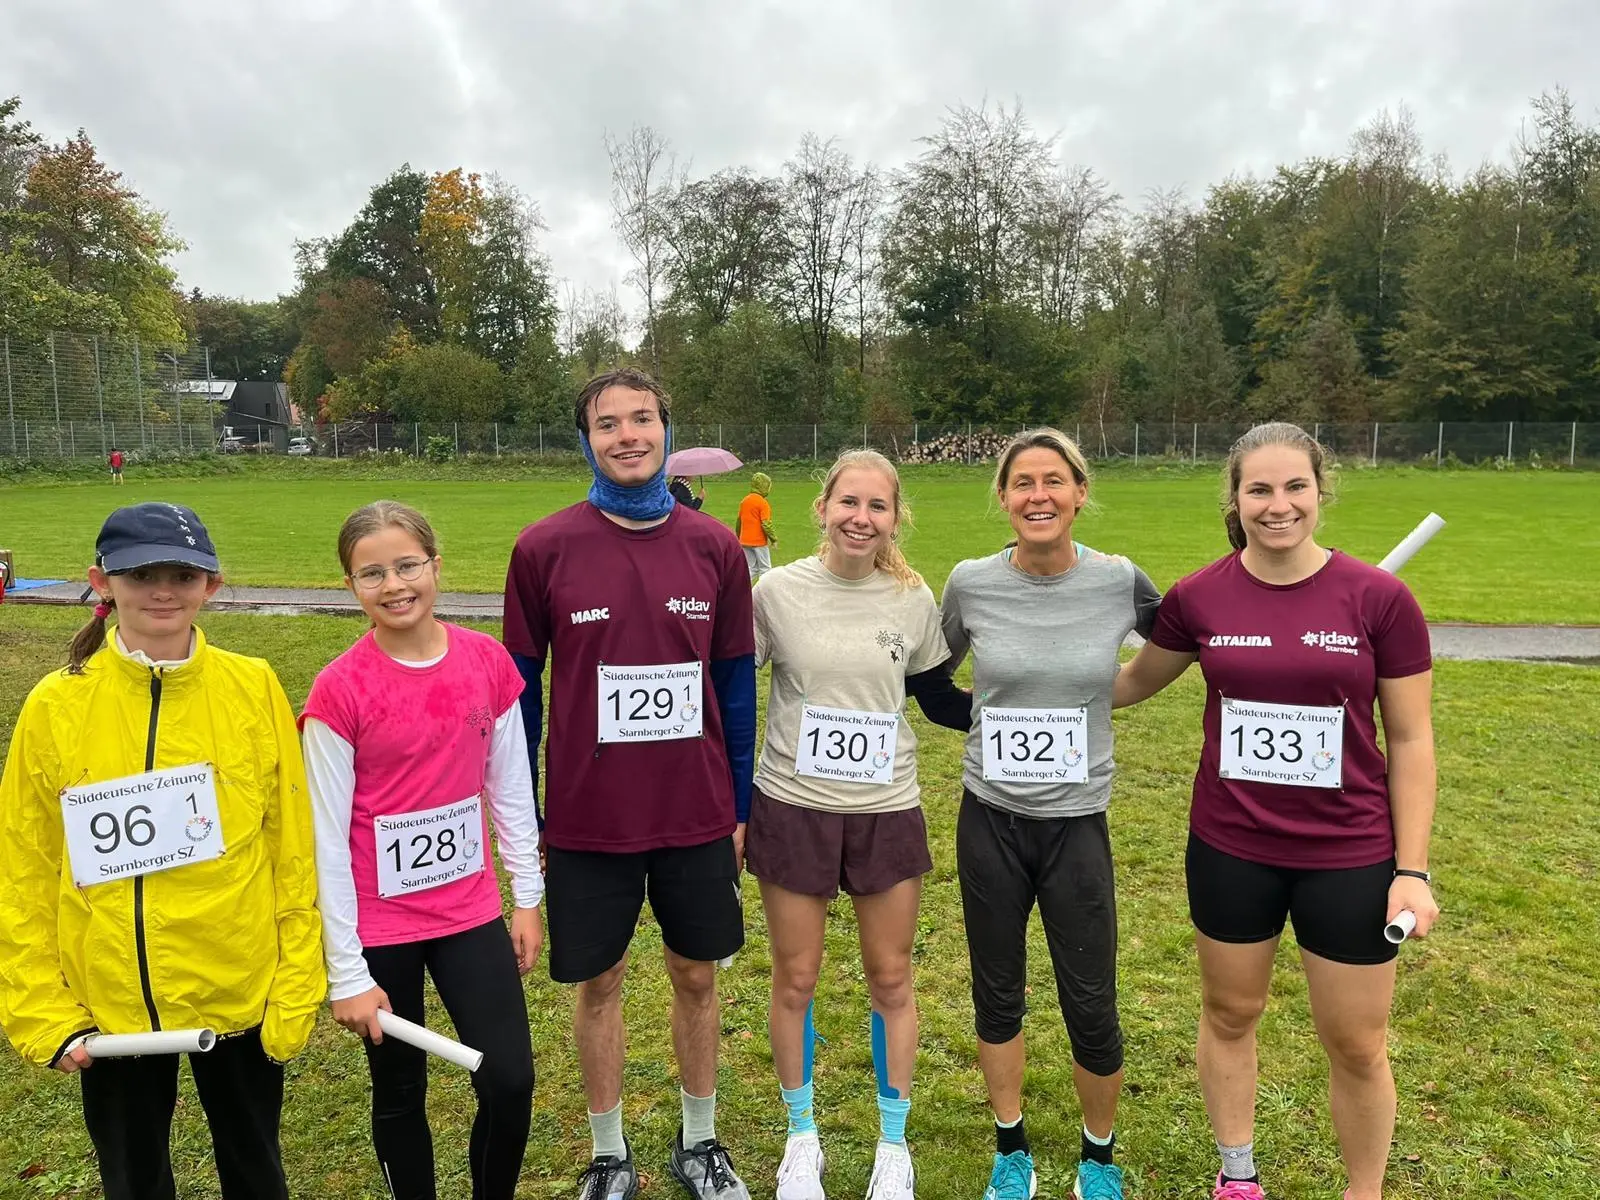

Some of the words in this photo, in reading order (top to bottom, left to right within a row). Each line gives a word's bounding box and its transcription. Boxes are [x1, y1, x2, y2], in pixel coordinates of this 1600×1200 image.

[571, 607, 610, 624] MARC
[681, 597, 710, 614] jdav
[686, 613, 710, 621] Starnberg
[1319, 630, 1358, 647] jdav
[1325, 645, 1358, 656] Starnberg
[603, 671, 666, 681] Süddeutsche
[666, 669, 699, 680] Zeitung
[607, 687, 674, 721] 129
[683, 684, 690, 702] 1
[806, 709, 864, 725] Süddeutsche
[864, 716, 896, 730] Zeitung
[986, 712, 1045, 723] Süddeutsche
[1045, 713, 1083, 725] Zeitung
[1227, 706, 1294, 721] Süddeutsche
[1295, 711, 1338, 726] Zeitung
[619, 726, 671, 738] Starnberger
[673, 725, 685, 734] SZ
[807, 727, 868, 762] 130
[878, 733, 886, 750] 1
[990, 730, 1055, 762] 132
[1065, 730, 1073, 747] 1
[1230, 725, 1303, 763] 133
[1317, 730, 1325, 749] 1
[814, 764, 862, 779] Starnberger
[864, 769, 876, 779] SZ
[1001, 768, 1054, 779] Starnberger
[1055, 769, 1068, 778] SZ
[1241, 765, 1301, 782] Starnberger
[1302, 772, 1317, 782] SZ
[67, 781, 154, 806] Süddeutsche
[154, 772, 207, 790] Zeitung
[90, 805, 156, 854] 96
[186, 792, 198, 815] 1
[380, 813, 448, 832] Süddeutsche
[447, 803, 478, 818] Zeitung
[386, 828, 457, 873] 128
[459, 822, 466, 840] 1
[100, 853, 176, 877] Starnberger
[177, 846, 196, 860] SZ
[401, 871, 456, 889] Starnberger
[456, 863, 468, 875] SZ
